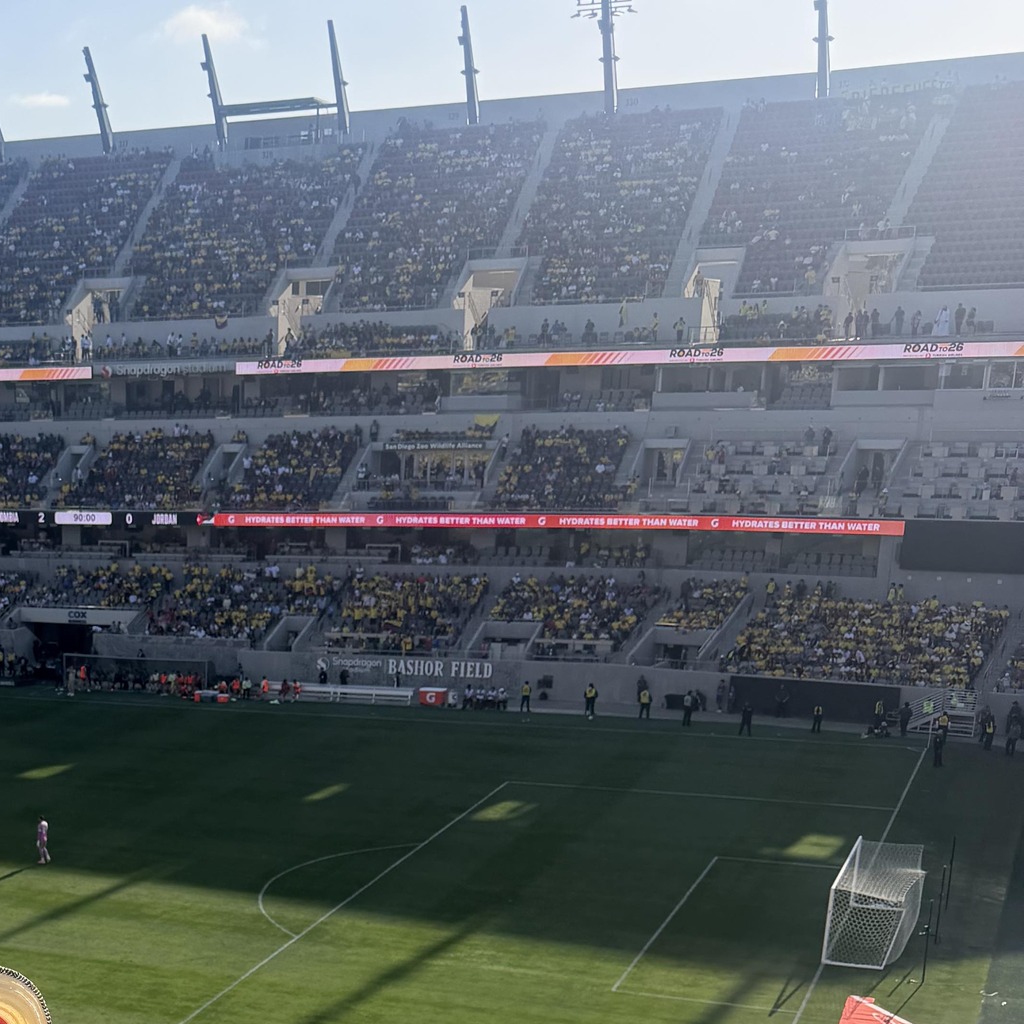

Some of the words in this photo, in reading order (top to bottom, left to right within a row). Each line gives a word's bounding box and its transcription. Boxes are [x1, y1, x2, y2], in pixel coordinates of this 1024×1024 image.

[116, 364, 180, 378] Snapdragon
[38, 512, 45, 523] 2
[74, 513, 96, 522] 90:00
[126, 512, 133, 525] 0
[228, 516, 235, 524] G
[245, 516, 285, 524] HYDRATES
[286, 516, 314, 524] BETTER
[315, 516, 337, 524] THAN
[338, 516, 365, 524] WATER
[376, 516, 384, 525] G
[395, 516, 438, 525] HYDRATES
[439, 516, 470, 525] BETTER
[472, 516, 495, 525] THAN
[496, 517, 525, 525] WATER
[538, 517, 546, 526] G
[559, 517, 604, 526] HYDRATES
[606, 517, 640, 526] BETTER
[642, 518, 666, 526] THAN
[668, 518, 698, 527] WATER
[711, 518, 719, 527] G
[732, 519, 780, 529] HYDRATES
[782, 520, 816, 530] BETTER
[818, 521, 845, 531] THAN
[847, 522, 881, 532] WATER
[332, 656, 382, 669] Snapdragon
[388, 659, 443, 677] BASHOR
[451, 661, 493, 679] FIELD
